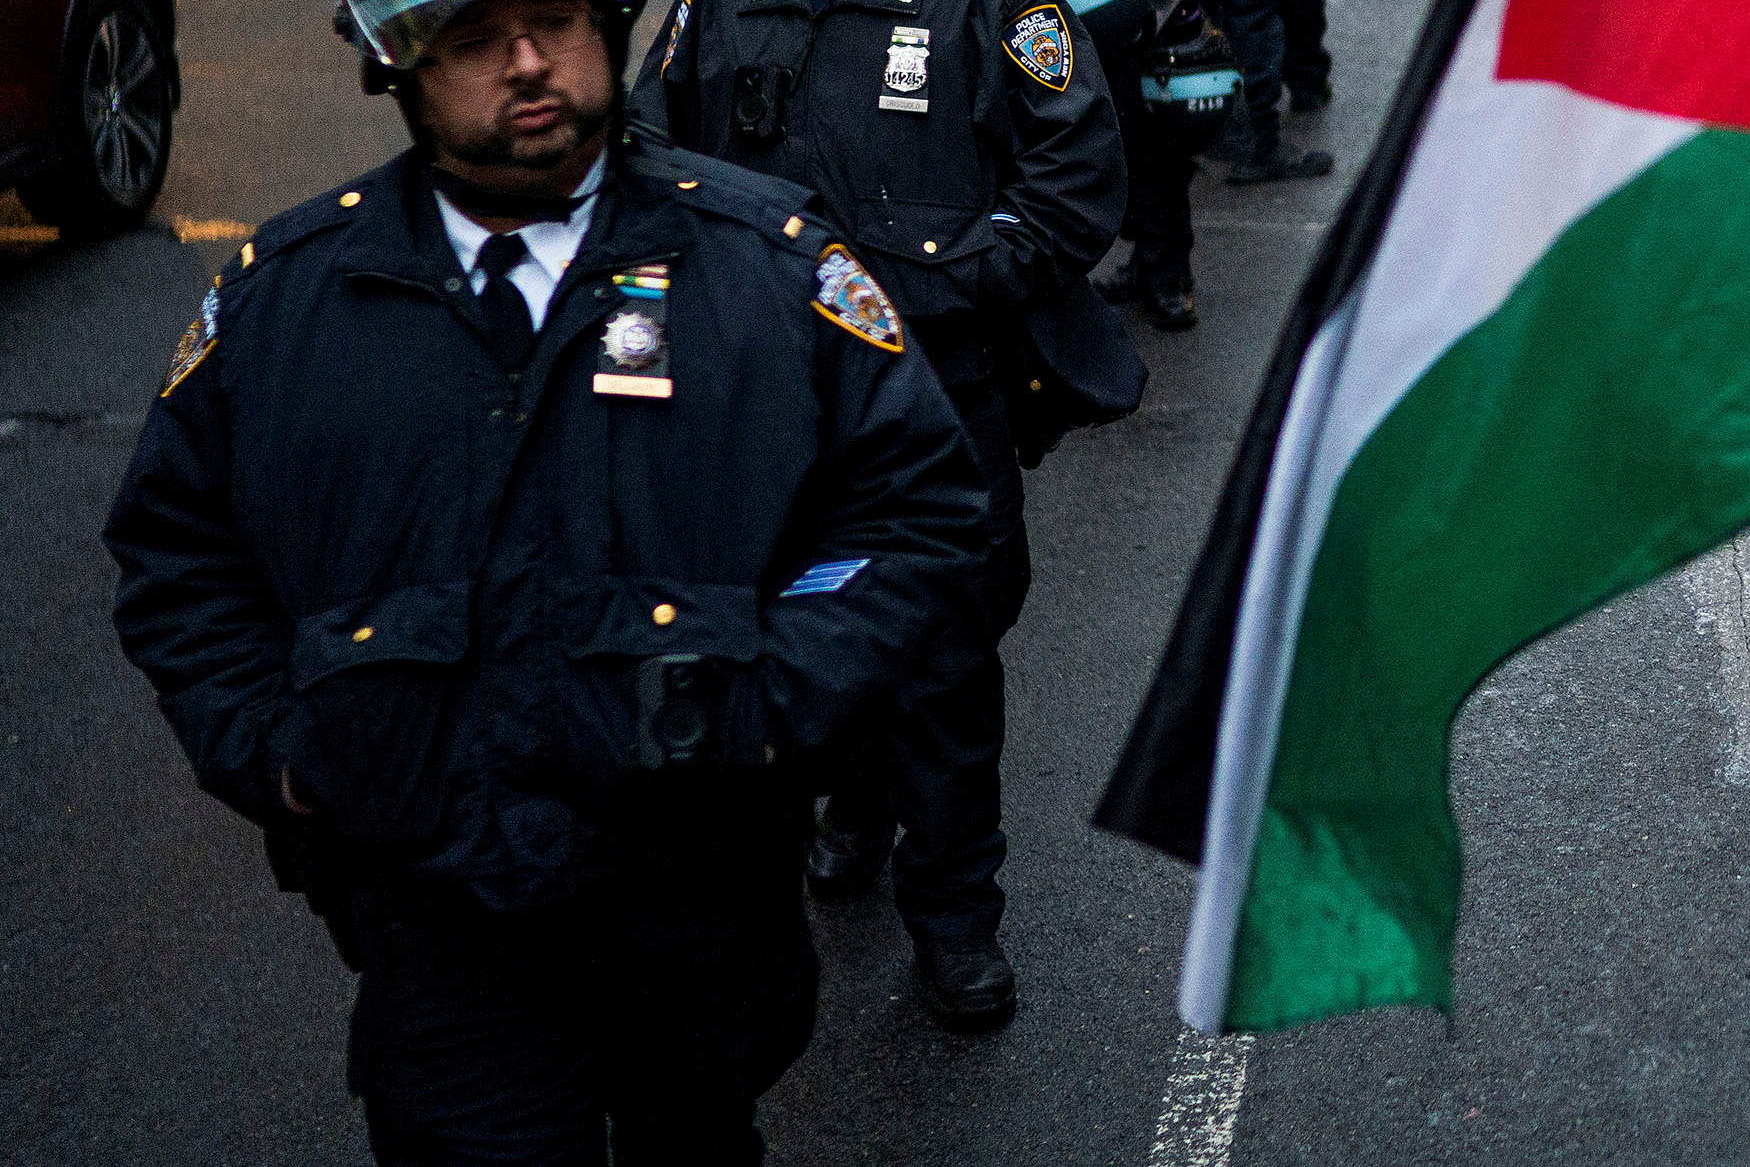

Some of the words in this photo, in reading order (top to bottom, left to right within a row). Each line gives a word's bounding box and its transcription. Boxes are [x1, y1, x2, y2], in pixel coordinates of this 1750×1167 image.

[1015, 12, 1047, 32] POLICE
[1010, 18, 1060, 49] DEPARTMENT
[1020, 55, 1040, 74] CITY
[888, 70, 922, 86] 14245
